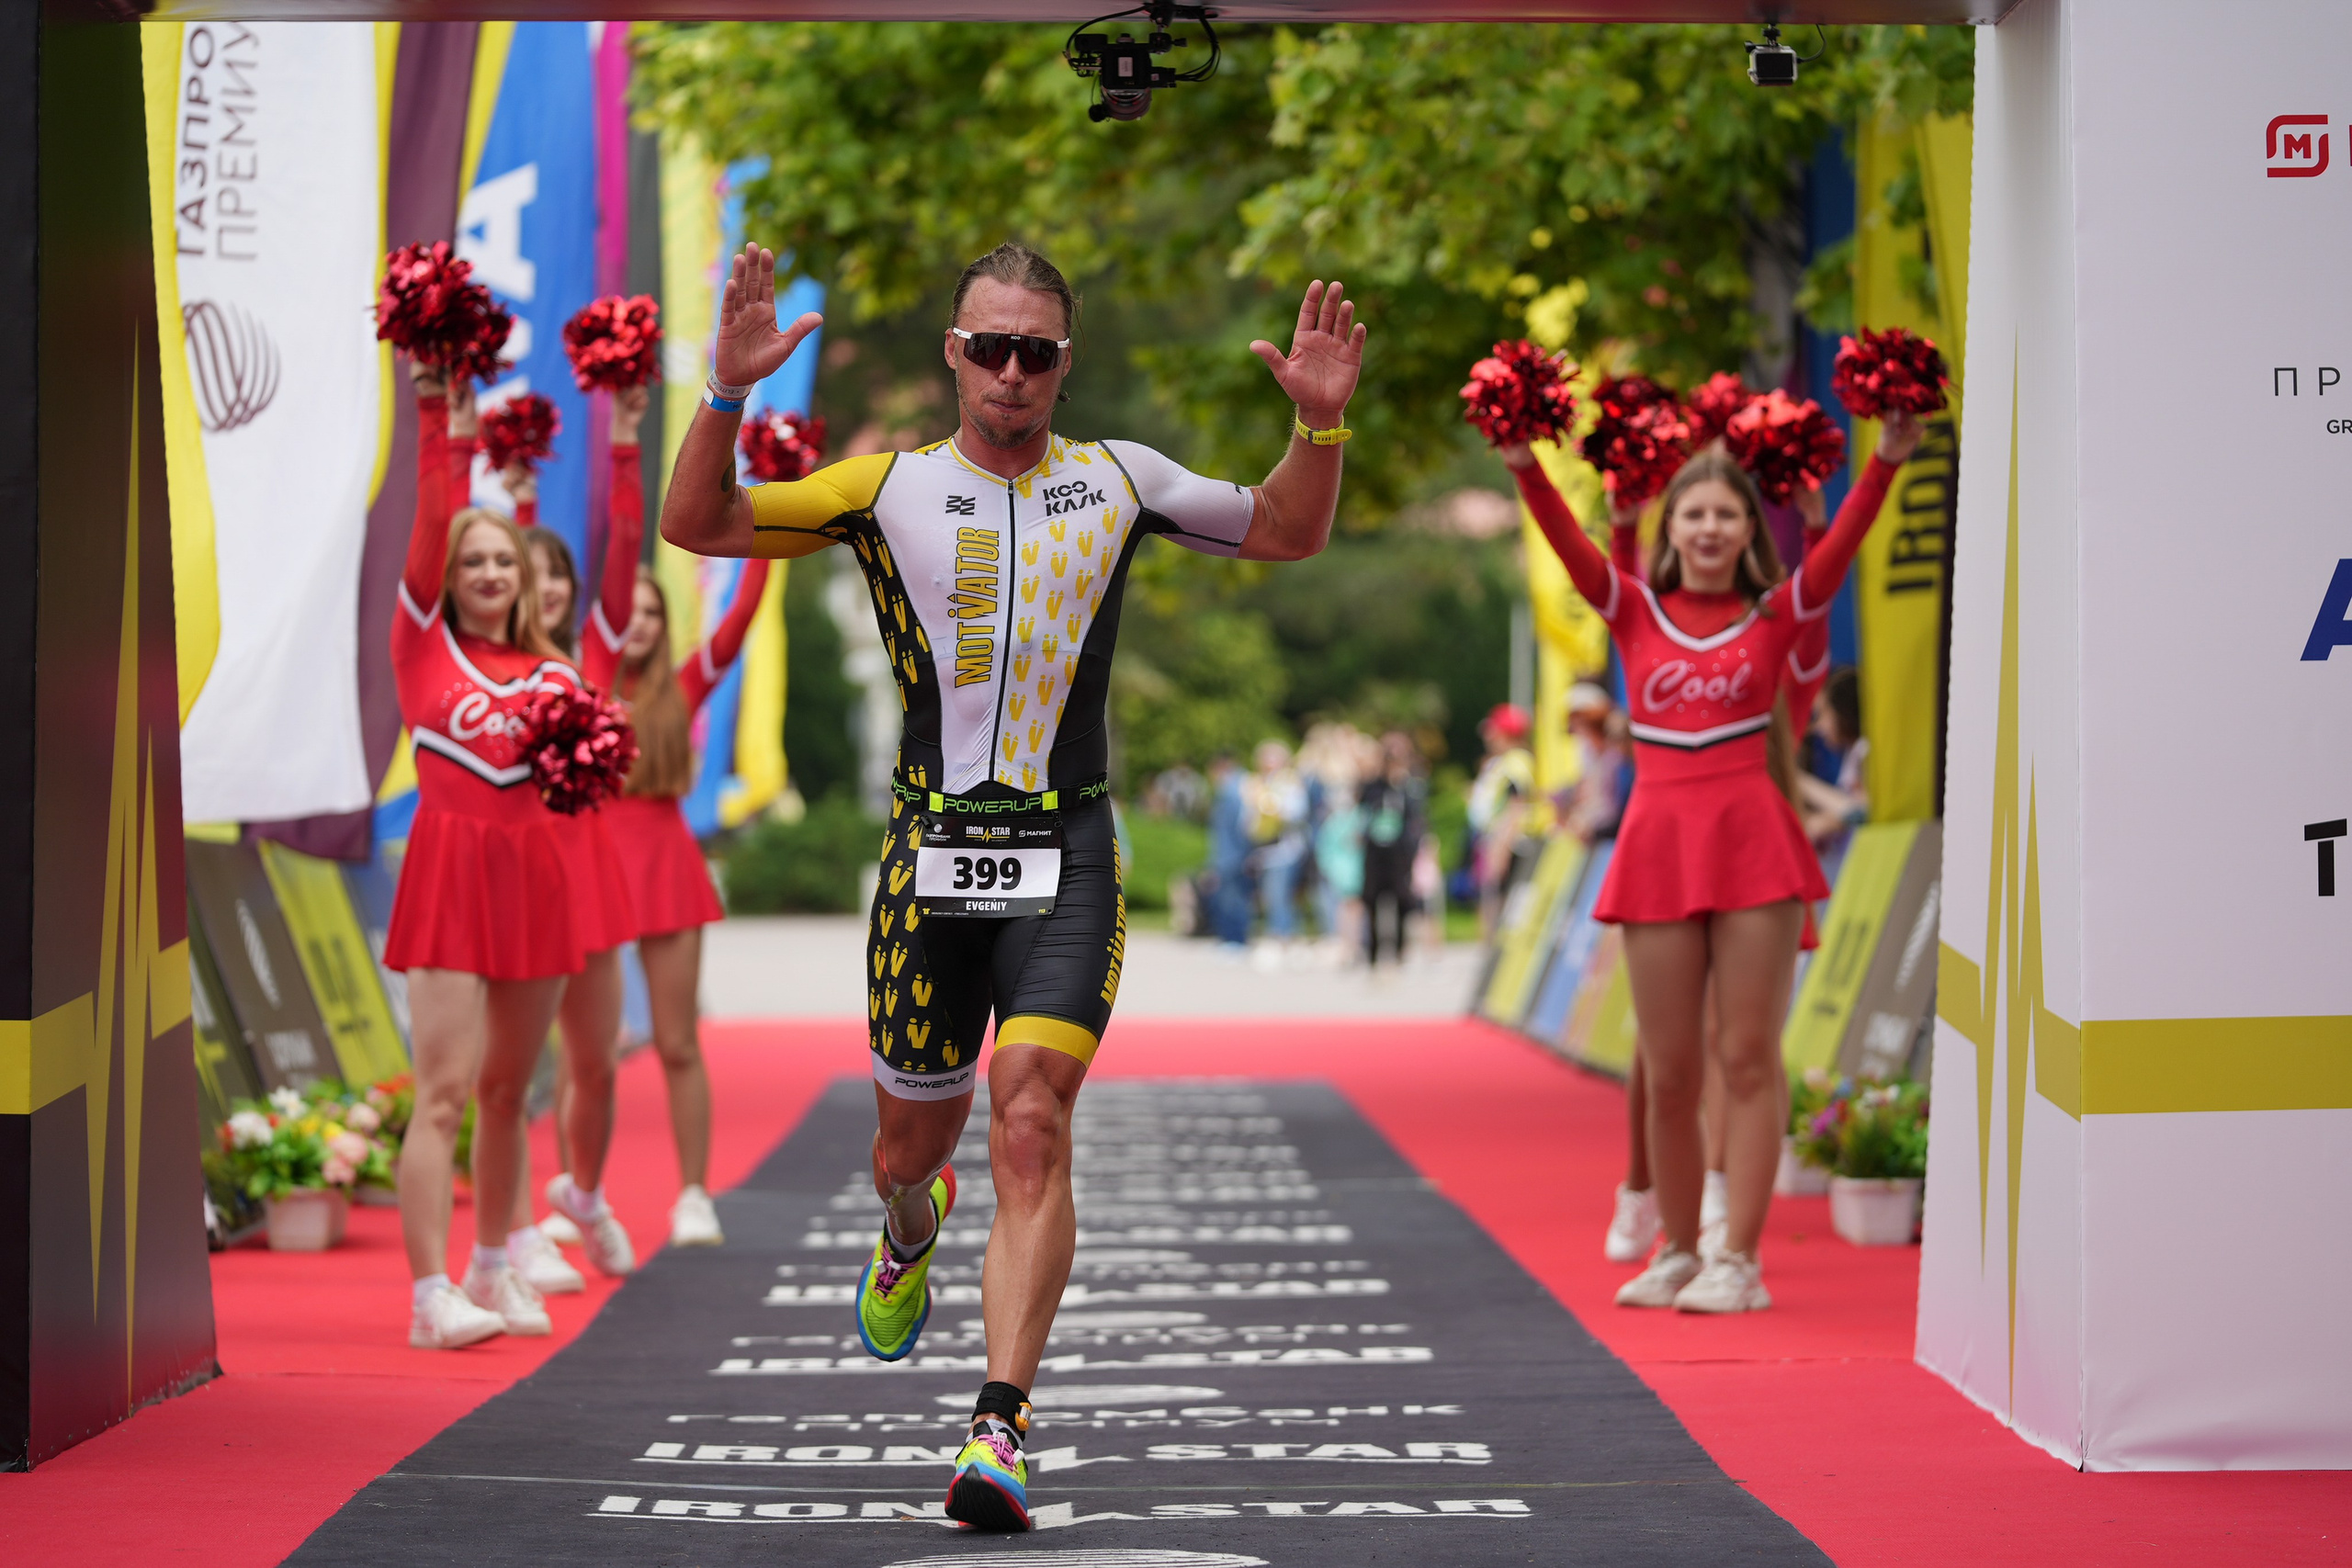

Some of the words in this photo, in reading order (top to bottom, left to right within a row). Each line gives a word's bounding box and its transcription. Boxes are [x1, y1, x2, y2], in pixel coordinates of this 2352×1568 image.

[1043, 480, 1088, 502] KOO
[1046, 488, 1107, 516] KASK
[1642, 659, 1753, 713] Cool
[448, 691, 526, 741] Coo
[944, 797, 1042, 813] POWERUP
[966, 826, 984, 835] IRON
[991, 827, 1011, 836] STAR
[953, 856, 1023, 891] 399
[966, 900, 1008, 911] EVGENIY
[895, 1072, 969, 1089] POWERUP
[644, 1442, 963, 1461] IRON
[1146, 1442, 1492, 1461] STAR
[598, 1495, 948, 1517] IRON
[1150, 1499, 1532, 1517] STAR
